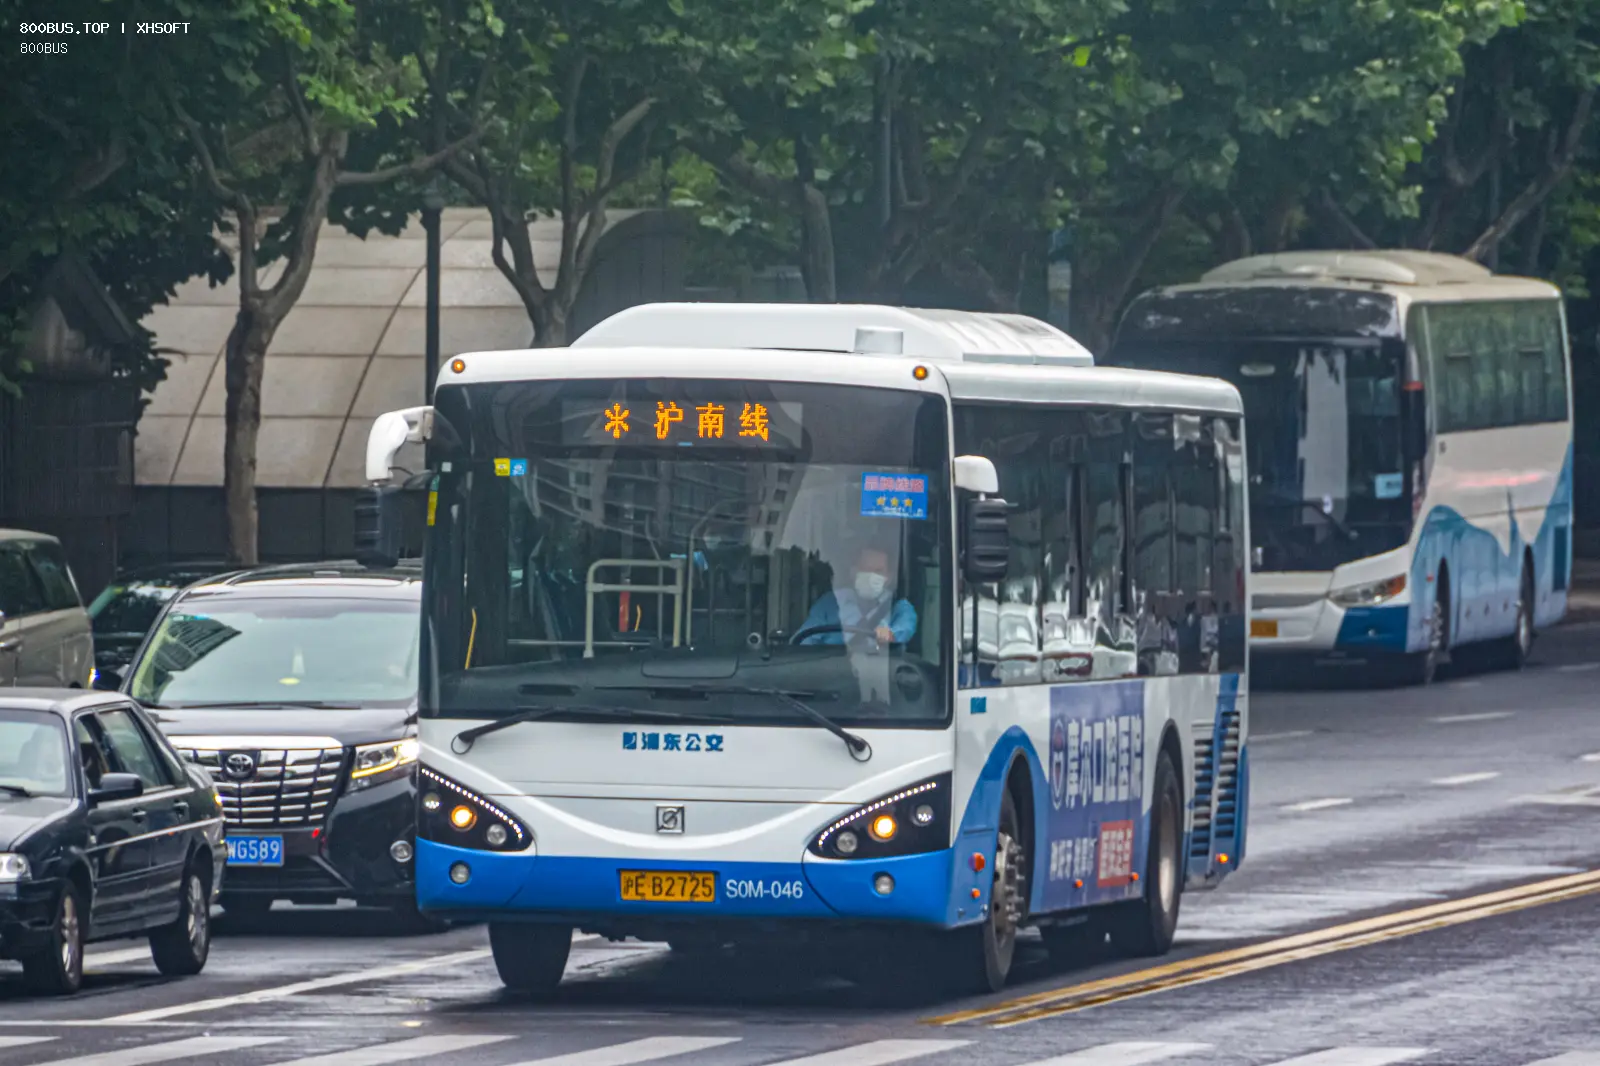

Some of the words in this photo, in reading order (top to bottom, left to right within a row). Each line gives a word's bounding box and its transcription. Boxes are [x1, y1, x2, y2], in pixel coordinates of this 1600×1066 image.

[653, 400, 769, 442] 沪南线
[641, 731, 724, 752] 浦东公交
